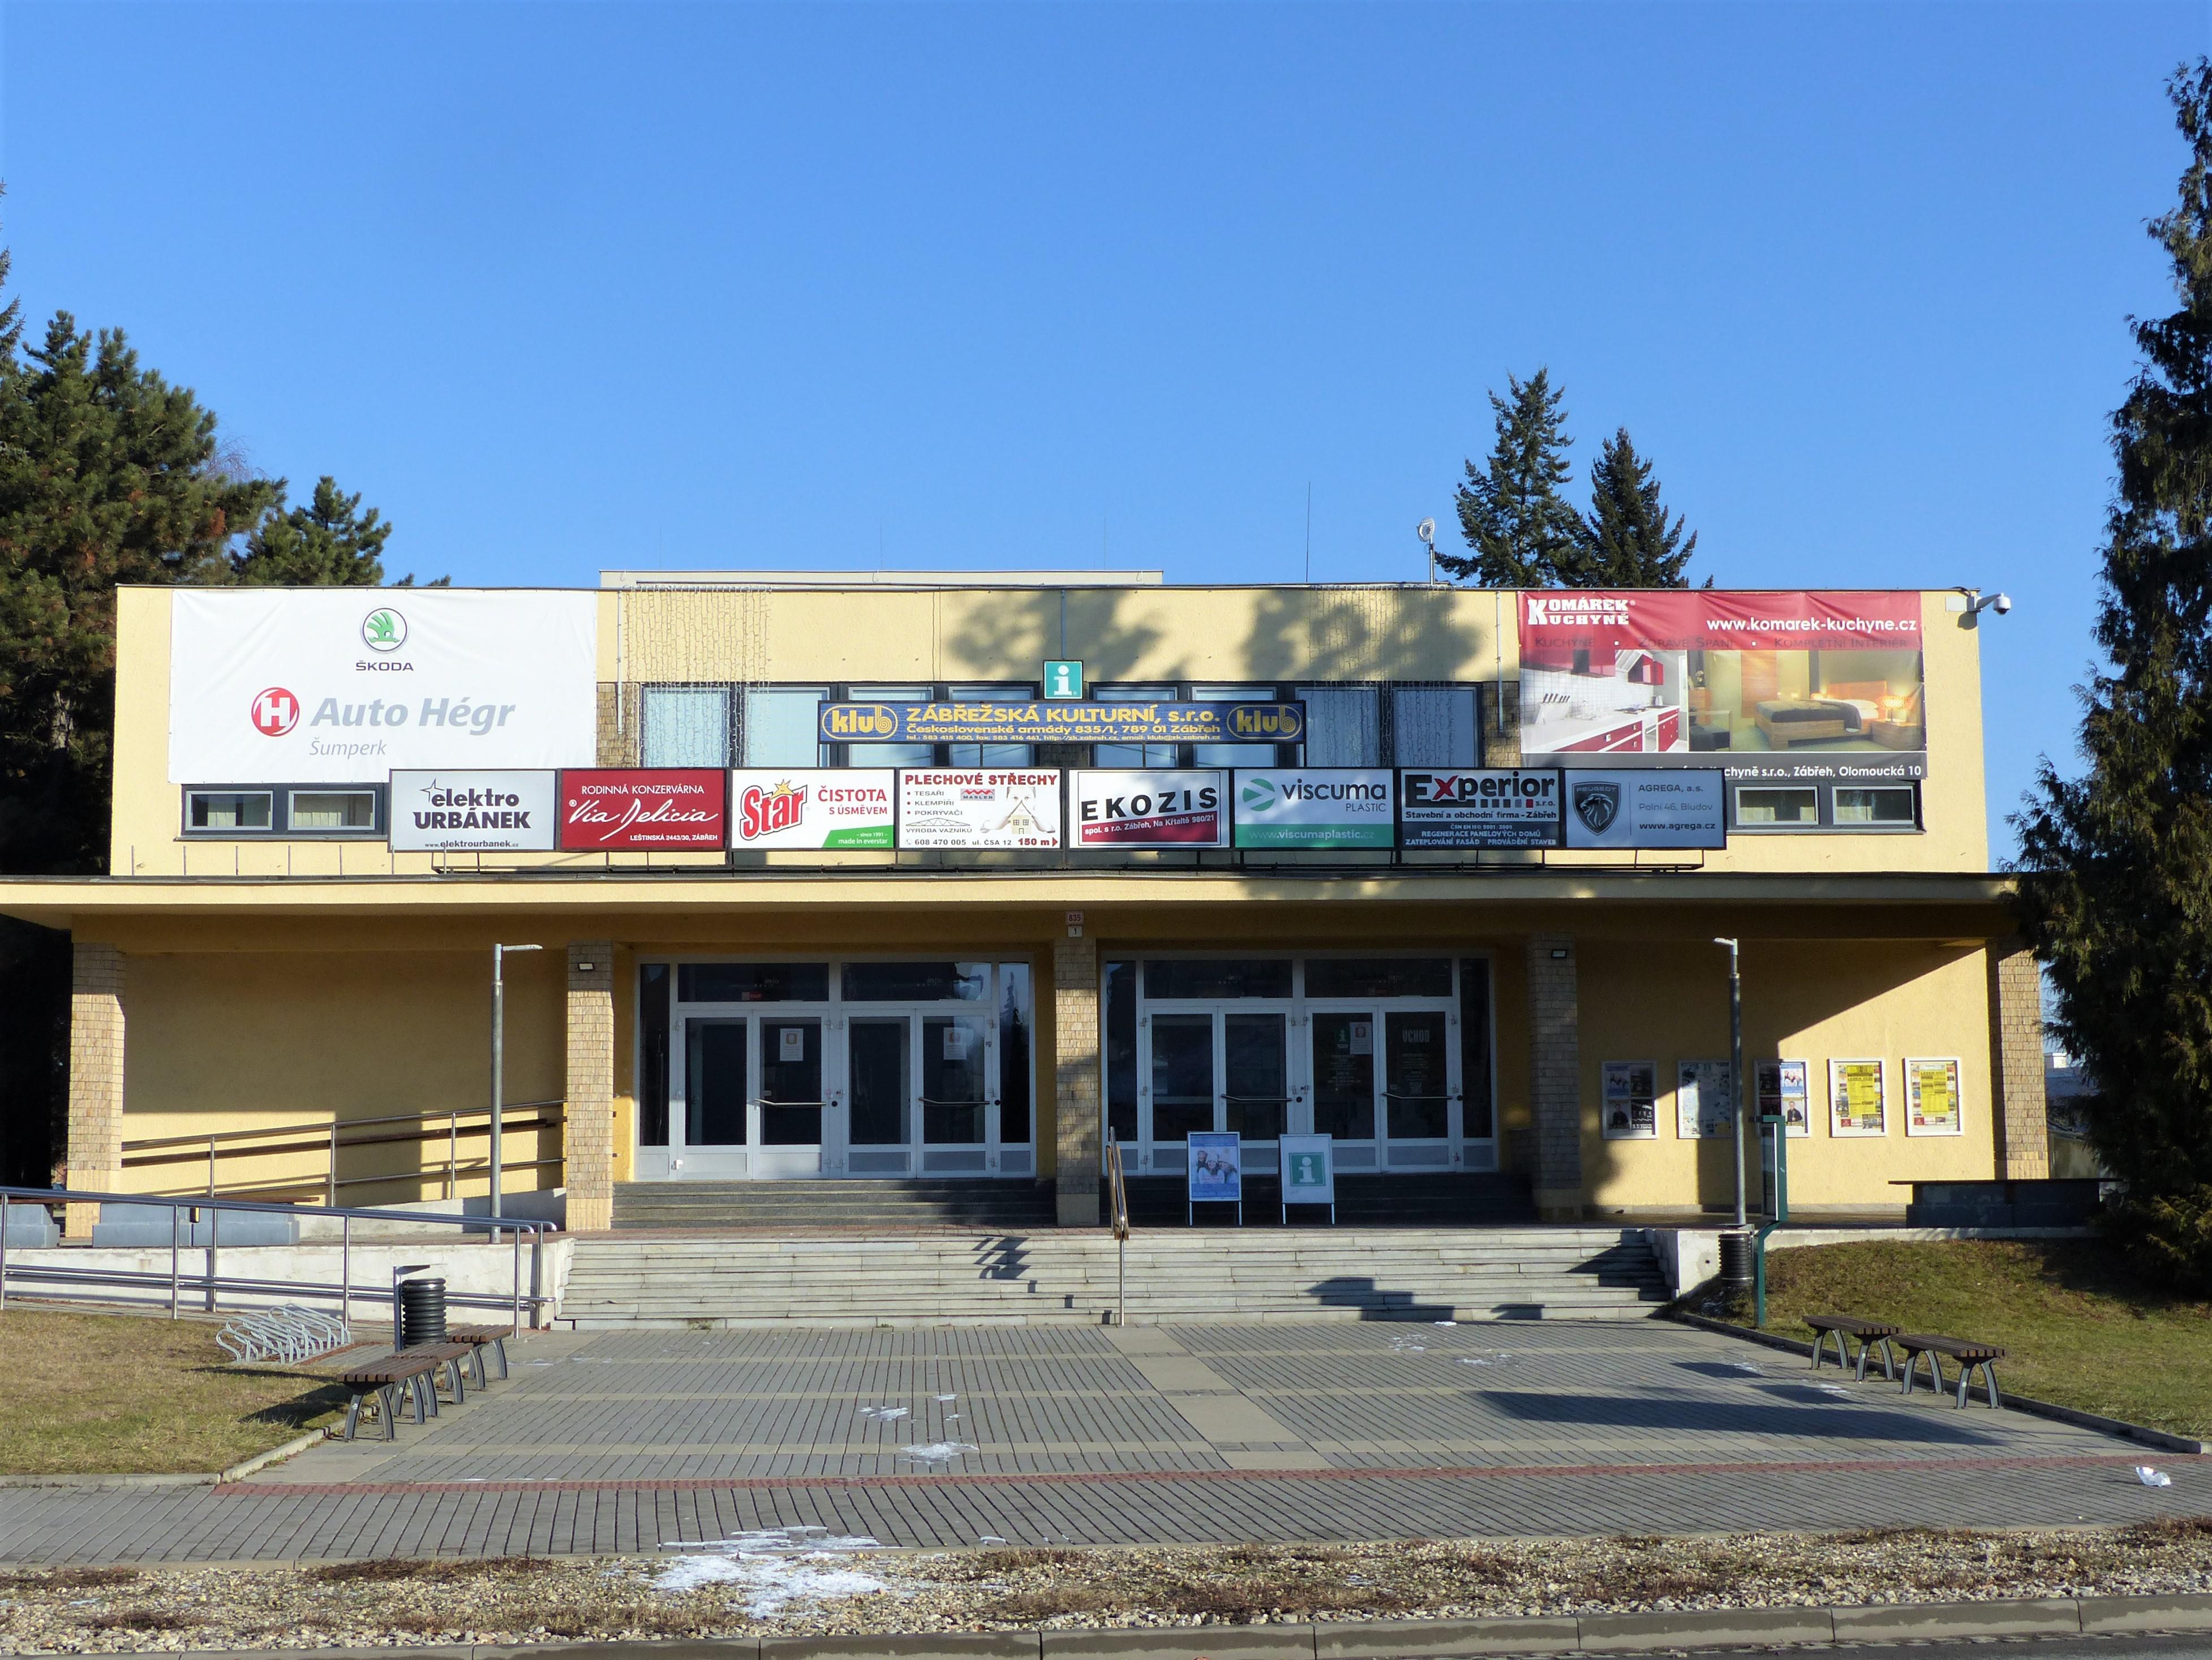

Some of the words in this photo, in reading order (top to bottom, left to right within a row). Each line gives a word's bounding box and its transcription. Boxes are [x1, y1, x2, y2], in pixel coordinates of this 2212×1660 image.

[1528, 597, 1629, 612] KOMÁREK
[1707, 617, 1917, 634] www.komarek-kuchyne.cz
[355, 660, 414, 671] ŠKODA
[310, 697, 408, 727] Auto
[419, 697, 516, 735] Hégr
[831, 705, 892, 734] klub
[906, 704, 1040, 722] ZÁBŘEŽSKÁ
[1047, 704, 1161, 724] KULTURNÍ,
[1168, 710, 1220, 722] s.r.o.
[1236, 705, 1296, 733] klub
[907, 723, 1014, 734] Československé
[1019, 725, 1071, 735] armády
[1075, 725, 1118, 734] 835/1,
[1171, 724, 1221, 734] Zábřeh
[310, 737, 386, 760] Šumperk
[905, 773, 983, 785] PLECHOVÉ
[989, 773, 1058, 785] STŘECHY
[1724, 766, 1759, 779] chyně
[1762, 767, 1791, 778] s.r.o.,
[1794, 766, 1835, 777] Zábřeh,
[1839, 765, 1904, 777] Olomoucká
[1908, 766, 1921, 776] 10
[432, 788, 519, 807] elektro
[582, 784, 629, 795] RODINNÁ
[632, 783, 705, 794] KONZERVÁRNA
[818, 785, 887, 802] ČISTOTA
[1281, 779, 1386, 800] viscuma
[1638, 784, 1684, 793] AGREGA,
[837, 804, 887, 814] ÚSMĚVEM
[1081, 787, 1217, 821] EKOZIS
[1346, 803, 1386, 812] PLASTIC
[413, 808, 531, 829] URBÁNEK
[569, 799, 620, 823] Via
[599, 798, 719, 841] Delicia
[743, 789, 804, 838] Star
[1085, 826, 1102, 835] spol.
[1124, 821, 1152, 830] Zábřeh,
[1192, 814, 1214, 823] 980/21
[1249, 829, 1375, 840] www.viscumaplastic.cz
